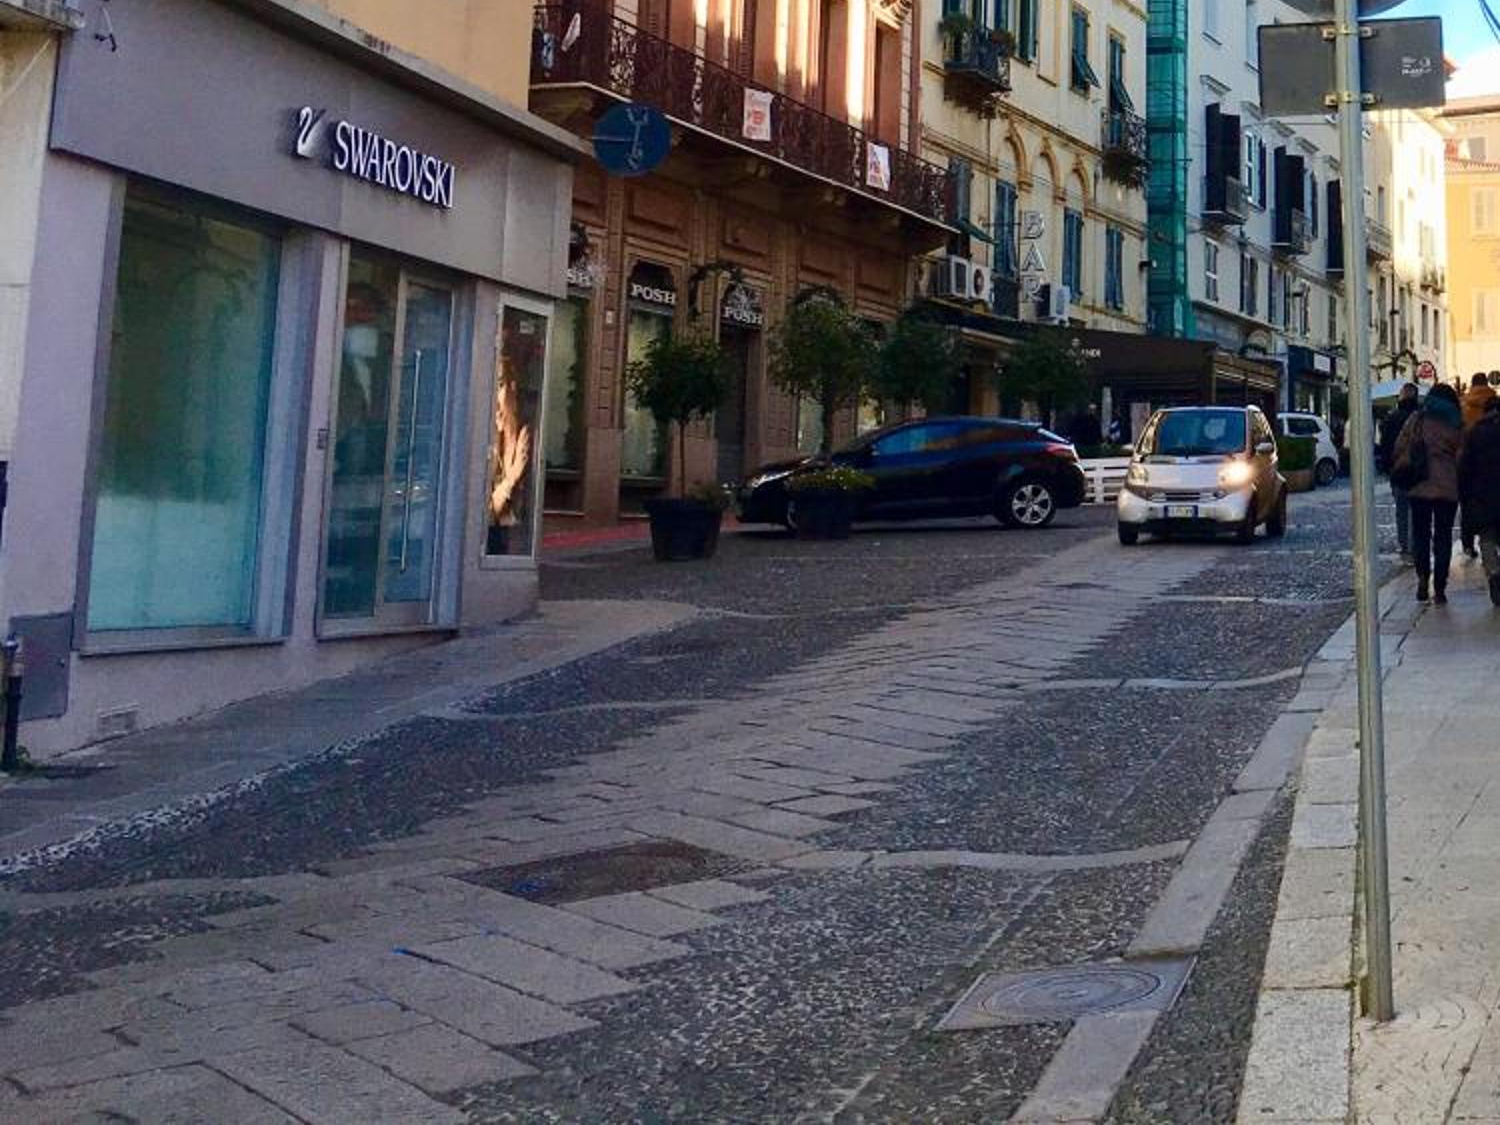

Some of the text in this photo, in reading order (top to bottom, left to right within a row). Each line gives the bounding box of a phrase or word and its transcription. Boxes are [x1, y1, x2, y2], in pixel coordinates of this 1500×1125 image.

[334, 120, 455, 208] SWAROVSKI
[631, 282, 677, 304] POSH
[724, 306, 764, 325] POSH
